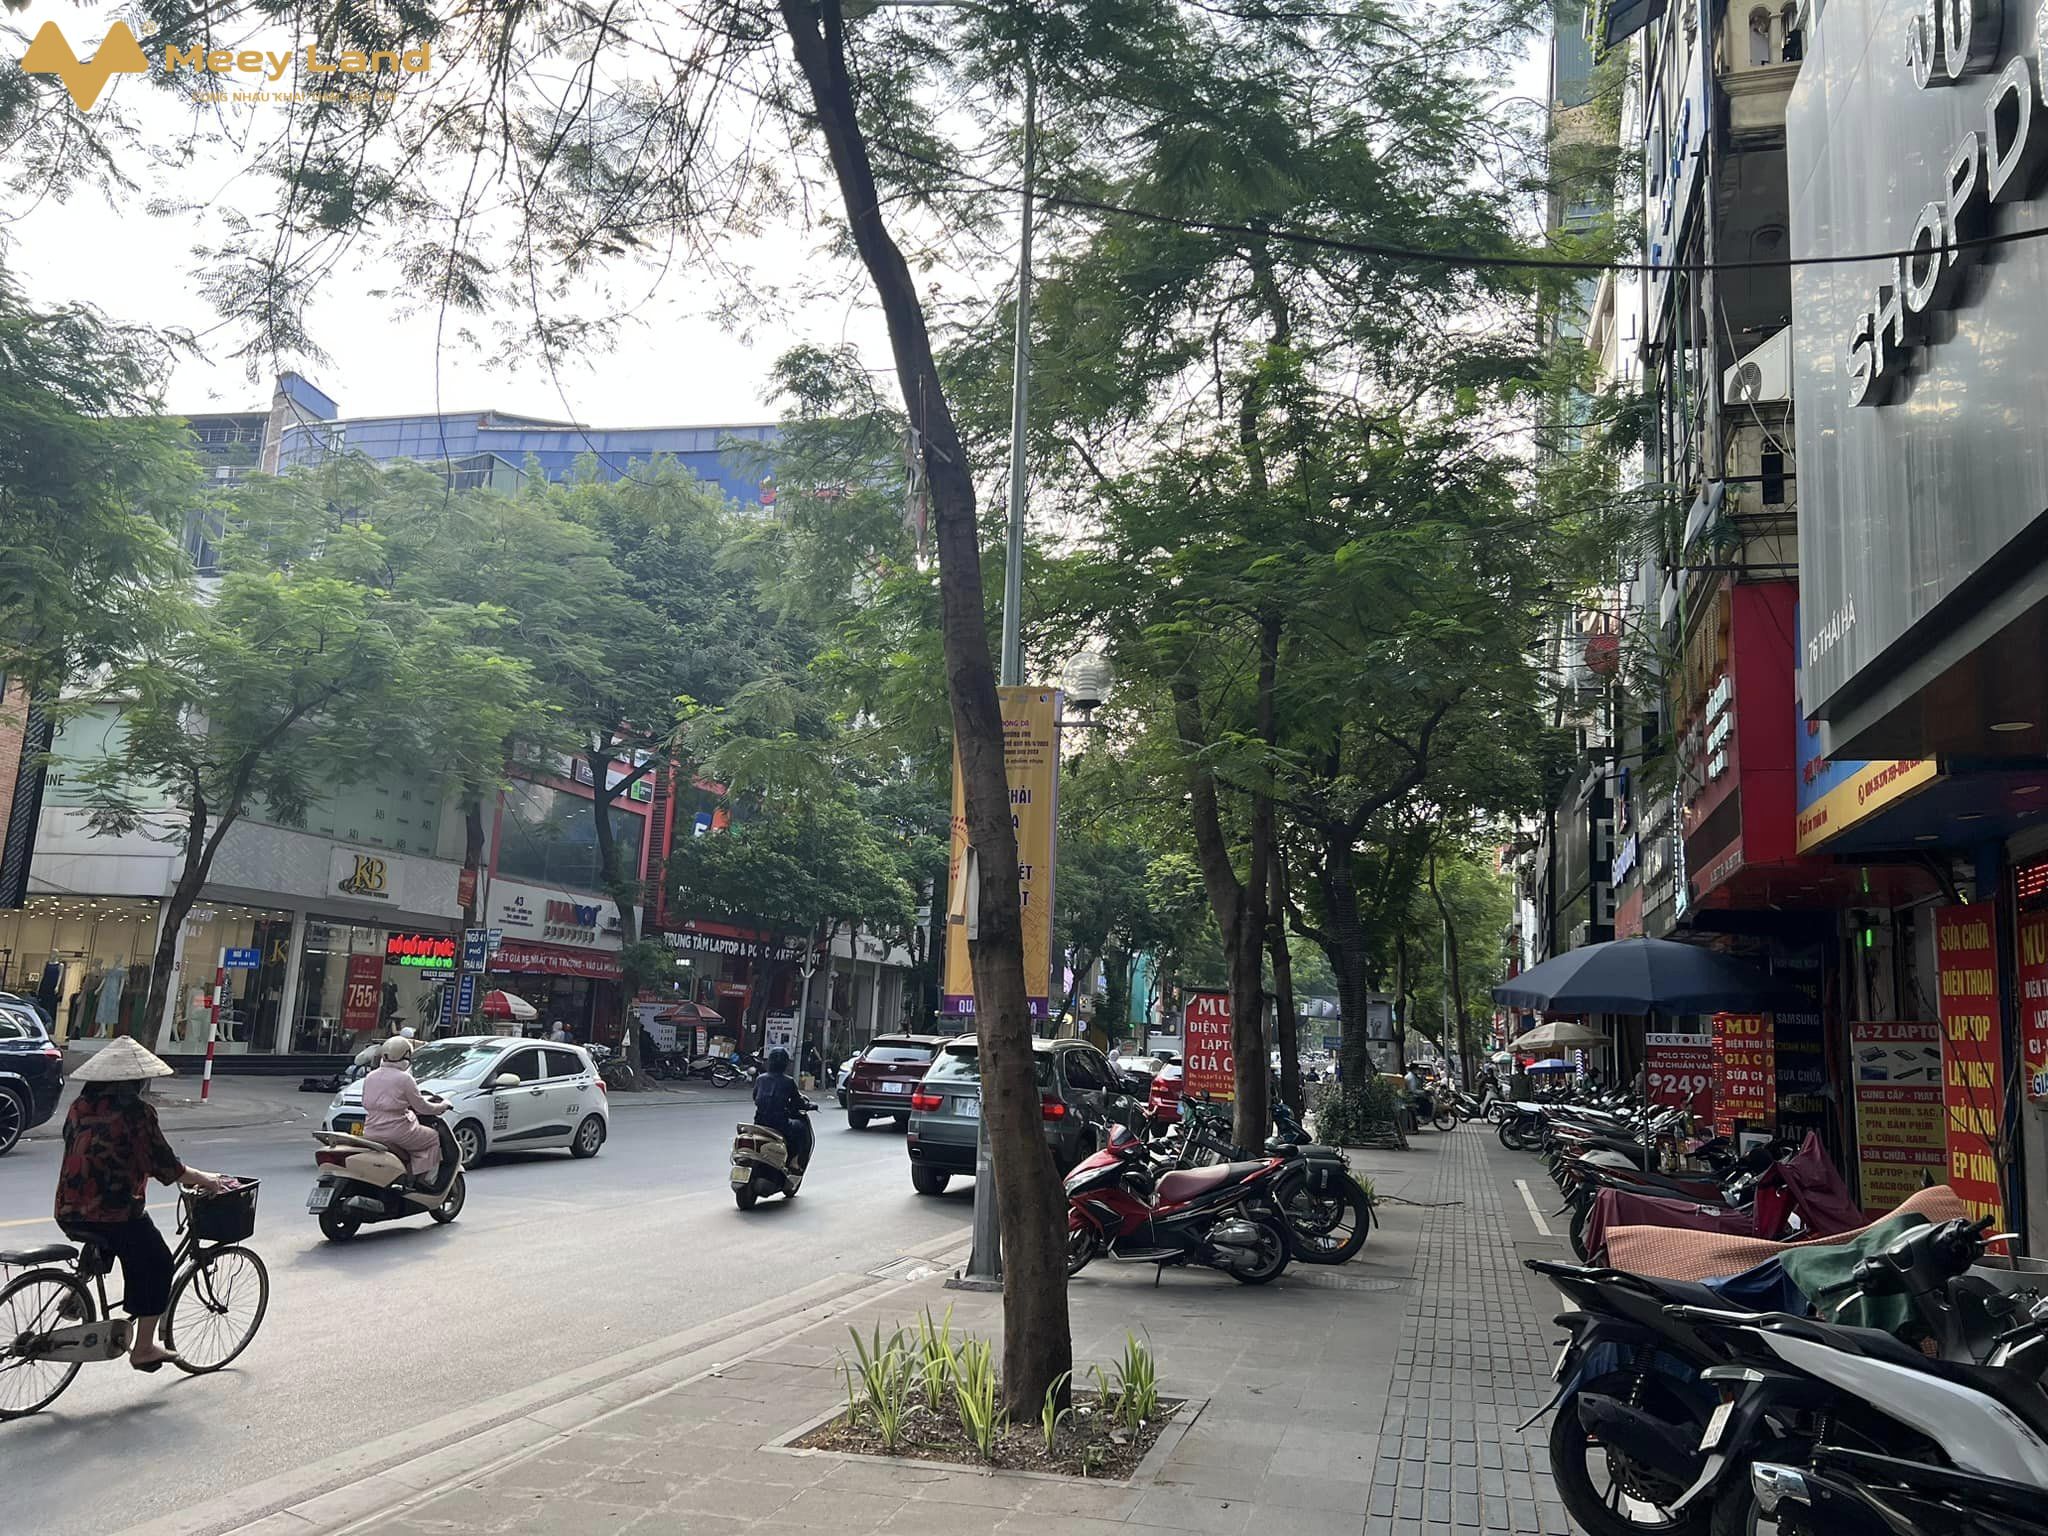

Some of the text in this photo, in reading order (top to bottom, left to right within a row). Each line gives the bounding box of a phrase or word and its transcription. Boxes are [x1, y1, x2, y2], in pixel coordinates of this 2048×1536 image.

[1846, 8, 2048, 408] SHOPD
[1808, 593, 1856, 667] 76 THÁI HÀ
[1009, 785, 1032, 804] HẢI
[514, 896, 524, 906] 43
[663, 932, 691, 949] TRUNG
[692, 934, 709, 951] TÂM
[710, 938, 738, 956] LAPTOP
[748, 944, 758, 958] PC
[1941, 919, 1990, 951] SỬA CHỮA
[1942, 965, 1993, 1001] ĐIỆN THOẠI
[1190, 1020, 1218, 1036] ĐIỆN
[1775, 1012, 1820, 1025] SAMSUNG
[1948, 1015, 1991, 1042] LAPTOP
[1856, 1026, 1884, 1038] A-Z
[1189, 1051, 1218, 1072] GIÁ
[1724, 1049, 1749, 1065] GIÁ
[1726, 1067, 1748, 1080] SỬA
[1948, 1051, 1995, 1089] LẤY NGAY
[1663, 1074, 1712, 1094] 249
[1732, 1085, 1746, 1096] ÉP
[1950, 1097, 1968, 1133] MỞ
[1953, 1146, 1968, 1179] ÉP
